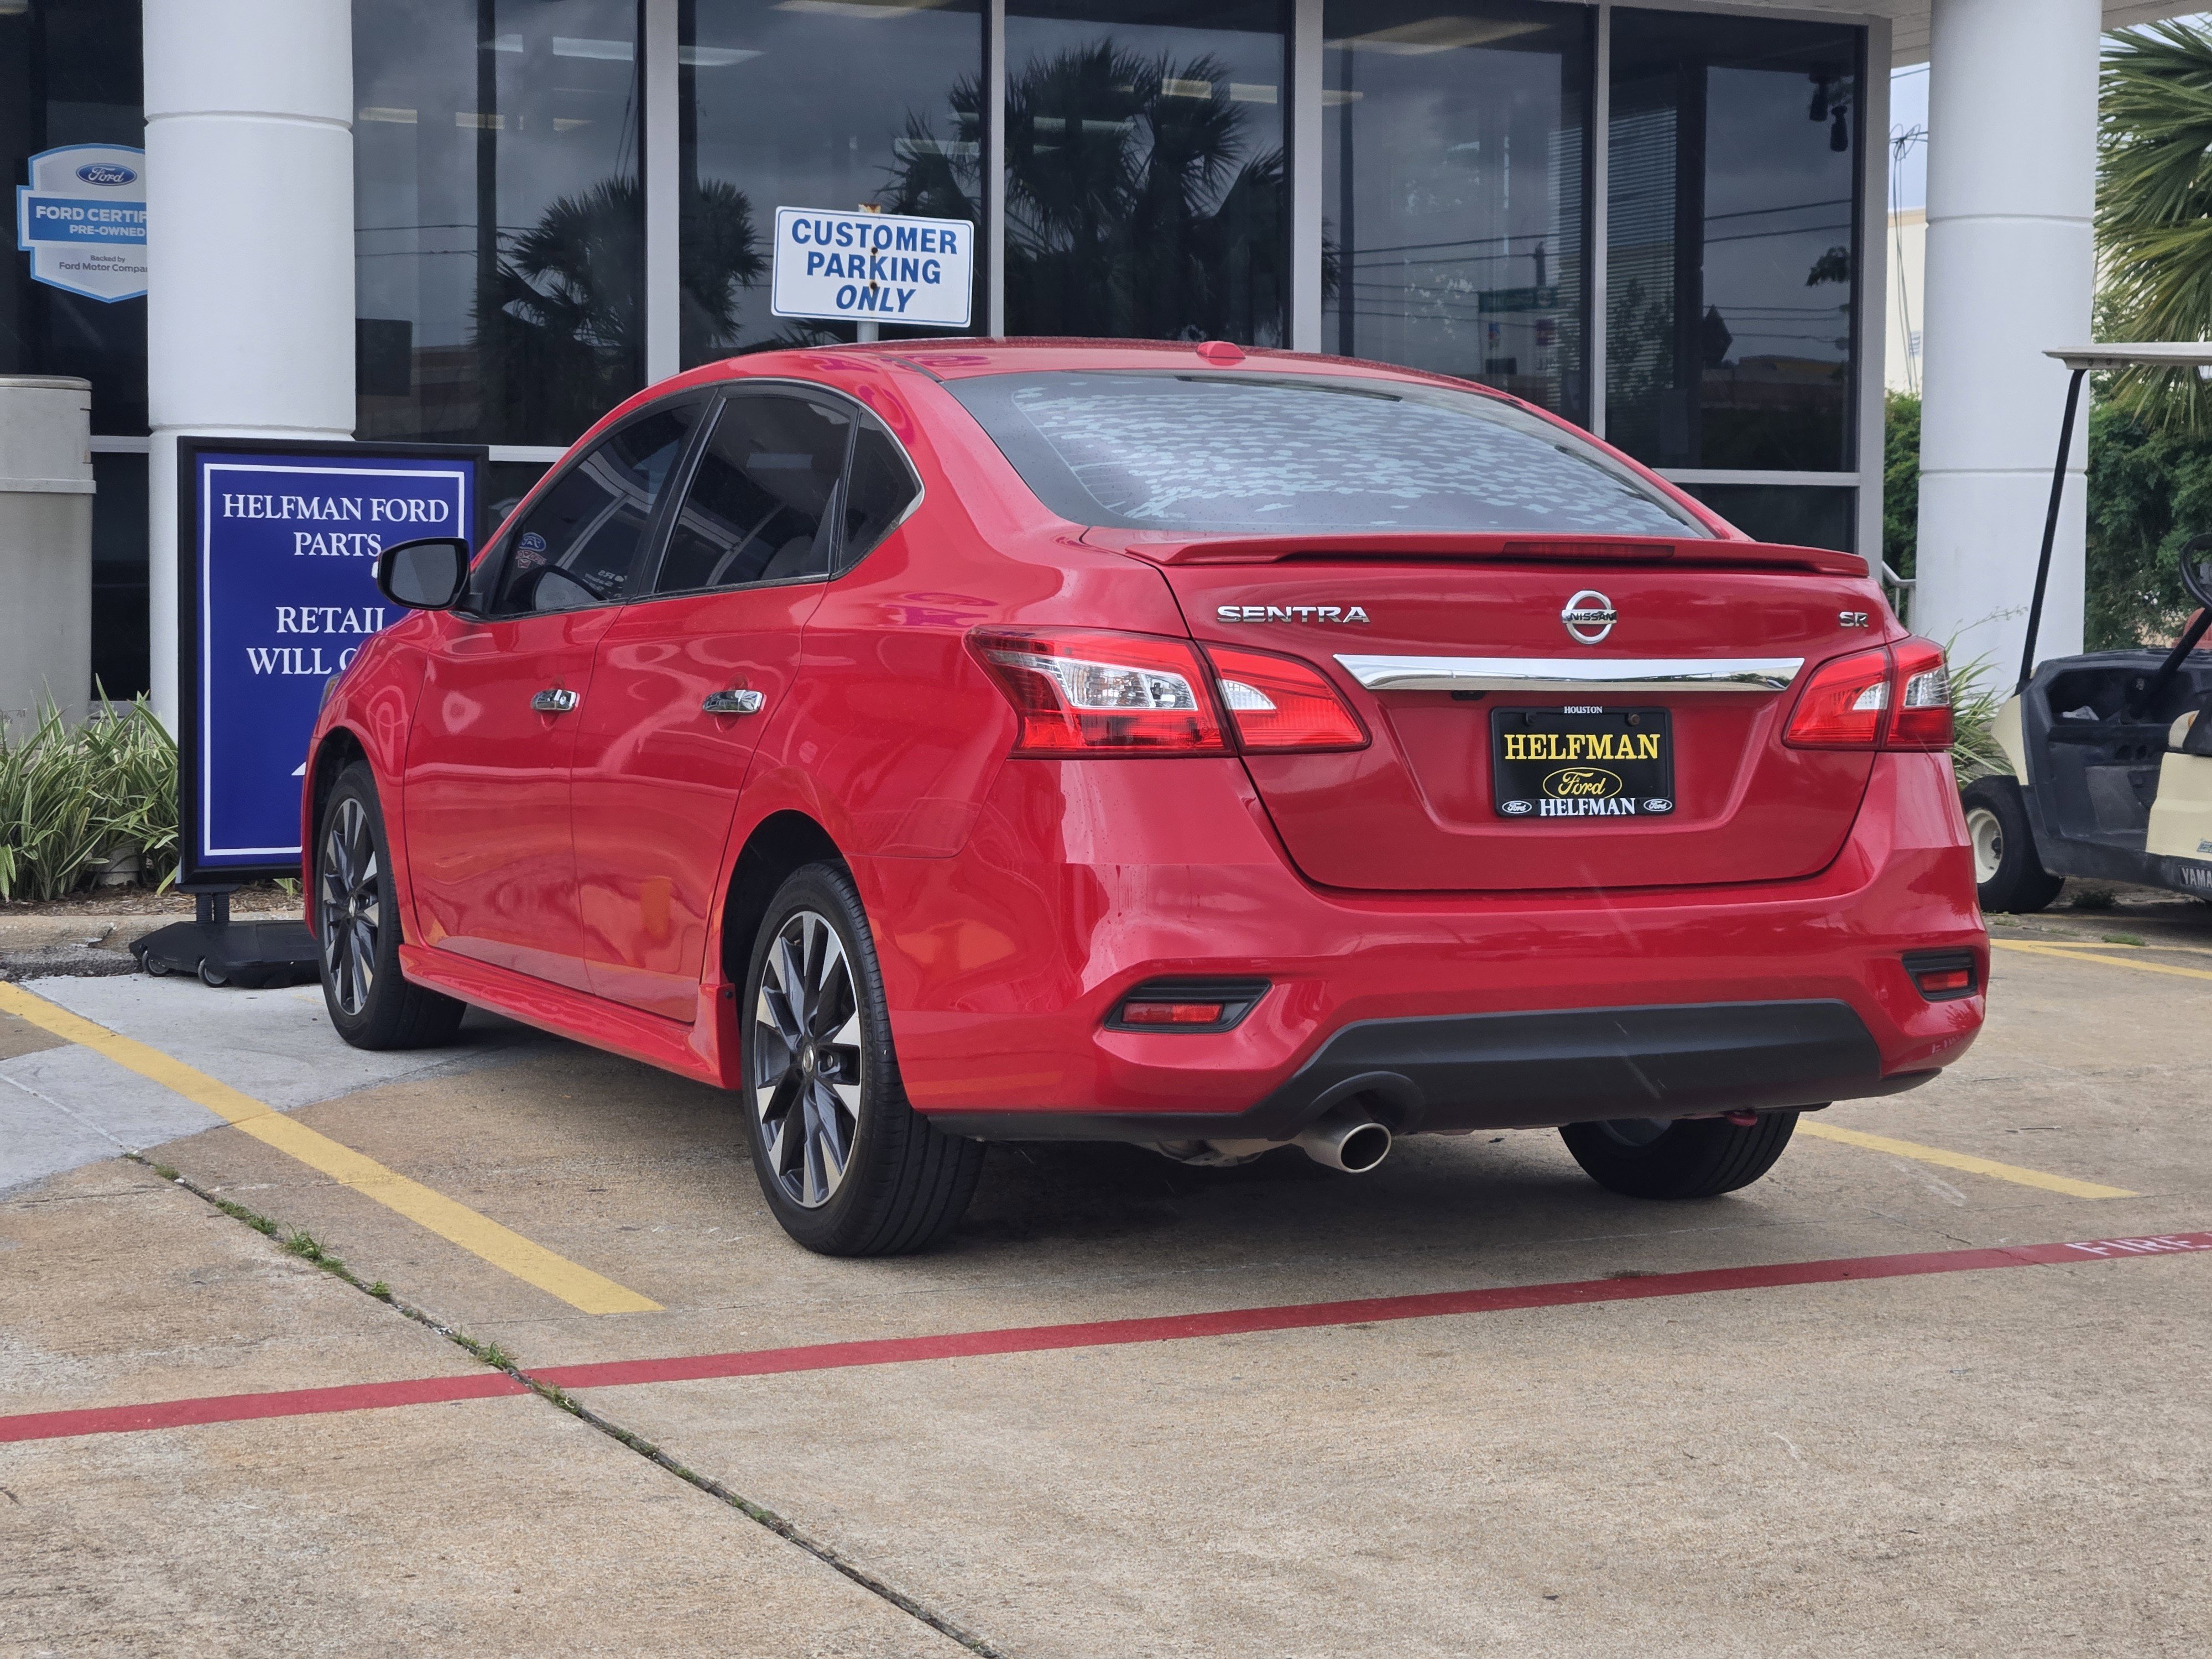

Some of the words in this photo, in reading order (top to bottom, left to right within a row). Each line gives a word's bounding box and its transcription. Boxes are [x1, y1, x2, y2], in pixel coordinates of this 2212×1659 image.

[87, 166, 125, 183] Ford
[36, 206, 84, 220] FORD
[69, 225, 145, 237] PRE-OWNED
[792, 218, 957, 254] CUSTOMER
[82, 263, 110, 271] Motor
[807, 251, 941, 284] PARKING
[836, 284, 916, 313] ONLY
[222, 494, 363, 520] HELFMAN
[370, 498, 448, 523] FORD
[293, 531, 382, 556] PARTS
[1217, 606, 1370, 623] SENTRA
[1570, 611, 1616, 621] NISSAN
[1839, 611, 1869, 628] SR
[246, 648, 332, 674] WILL
[1564, 706, 1603, 714] HOUSTON
[1504, 734, 1661, 759] HELFMAN
[1558, 771, 1606, 795] Ford
[1506, 802, 1527, 812] Ford
[1539, 797, 1636, 816] HELFMAN
[1647, 800, 1668, 810] Ford
[2064, 1235, 2212, 1256] FIRE
